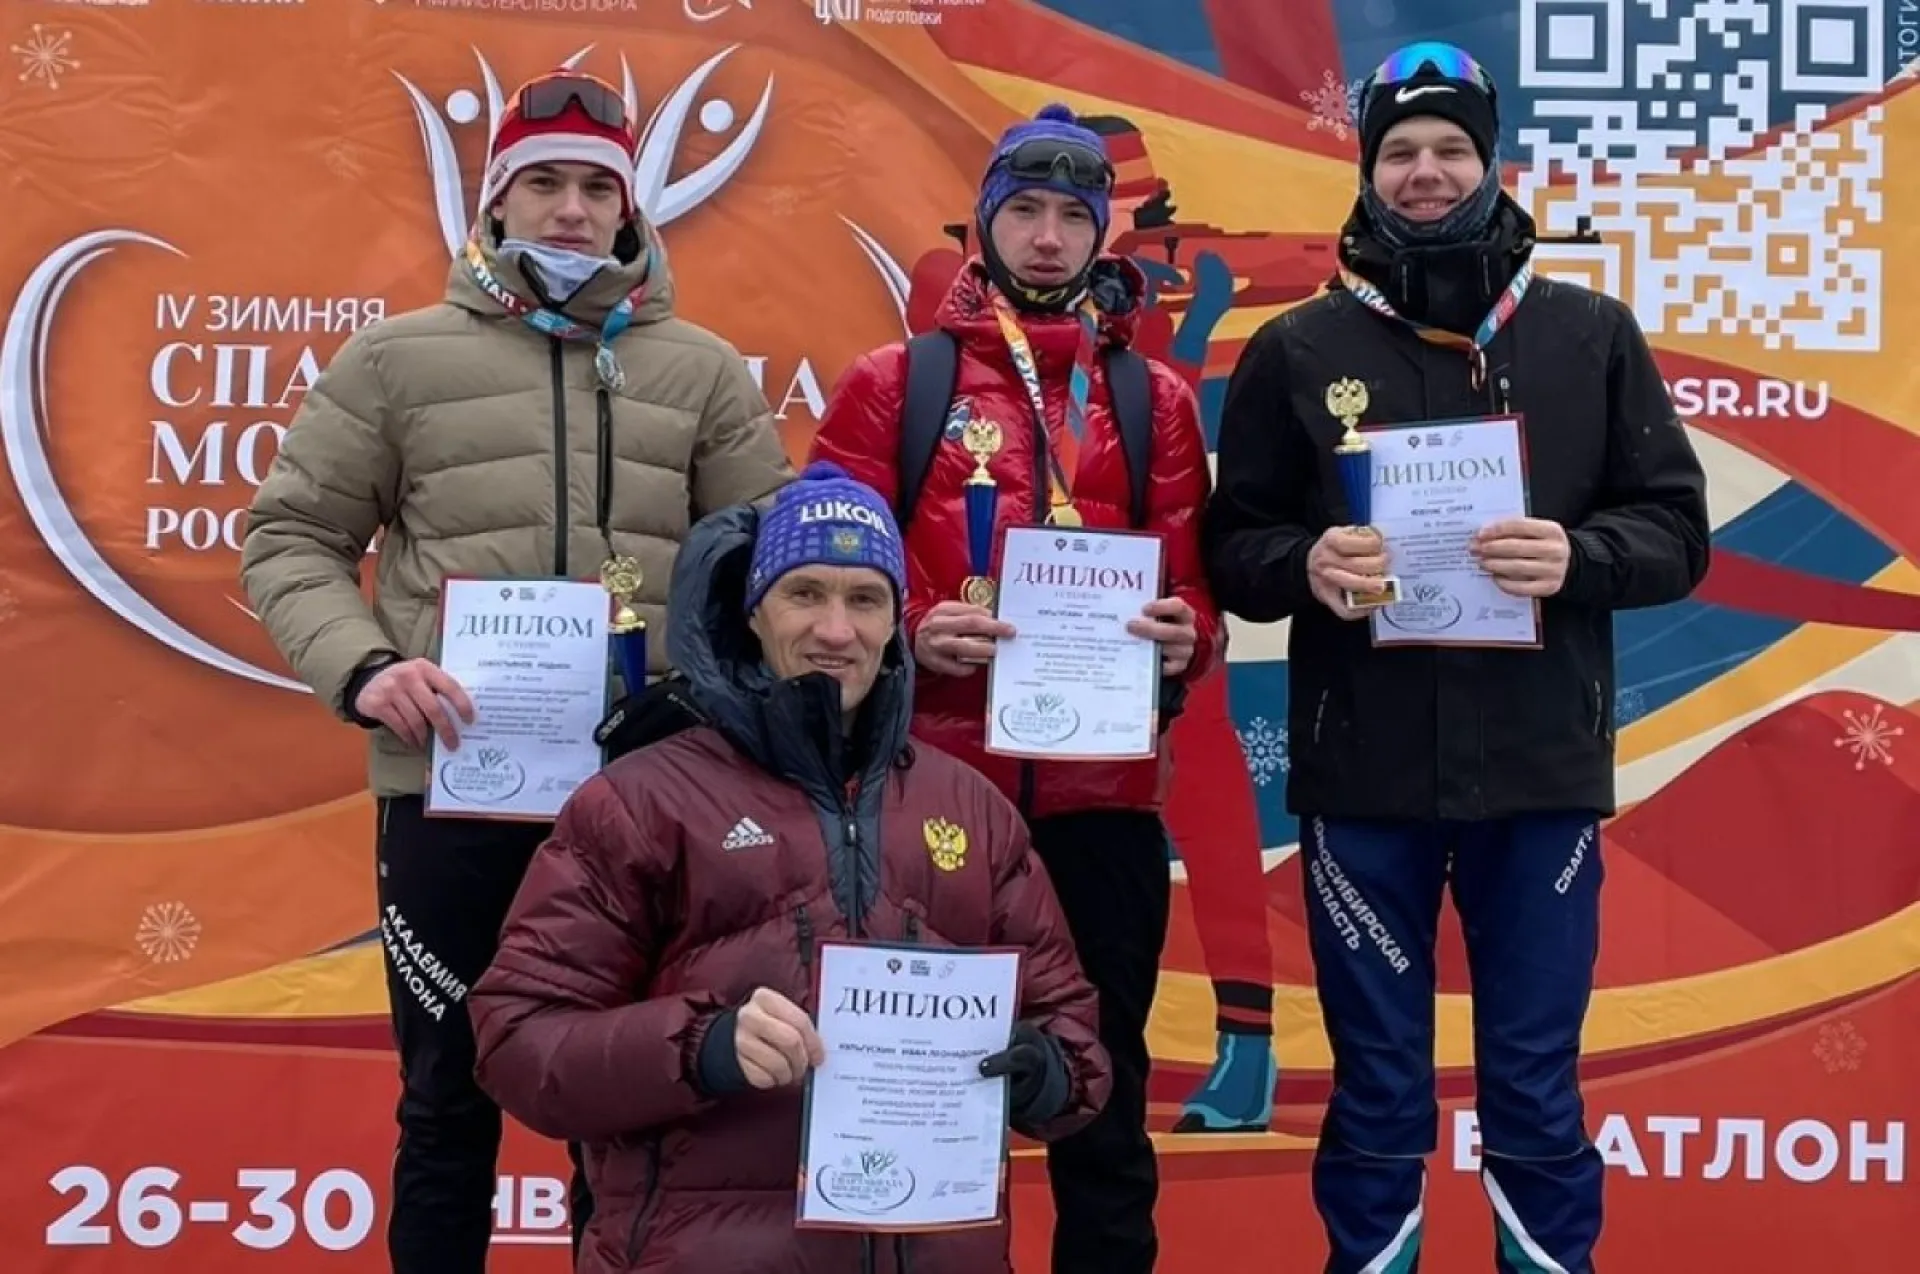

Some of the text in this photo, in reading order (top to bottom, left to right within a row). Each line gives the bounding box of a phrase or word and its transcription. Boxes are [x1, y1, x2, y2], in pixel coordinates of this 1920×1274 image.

[156, 293, 385, 335] IV ЗИМНЯЯ
[1664, 377, 1830, 420] SR.RU
[1371, 456, 1506, 487] ДИПЛОМ
[800, 500, 891, 538] LUKOIL
[1014, 562, 1145, 592] ДИПЛОМ
[456, 614, 595, 638] ДИПЛОМ
[721, 834, 775, 851] adidas
[1311, 859, 1361, 951] ОБЛАСТЬ
[386, 904, 468, 1003] АКАДЕМИЯ
[834, 986, 1000, 1020] ДИПЛОМ
[1453, 1109, 1906, 1183] БАТЛОН
[45, 1165, 376, 1251] 26-30
